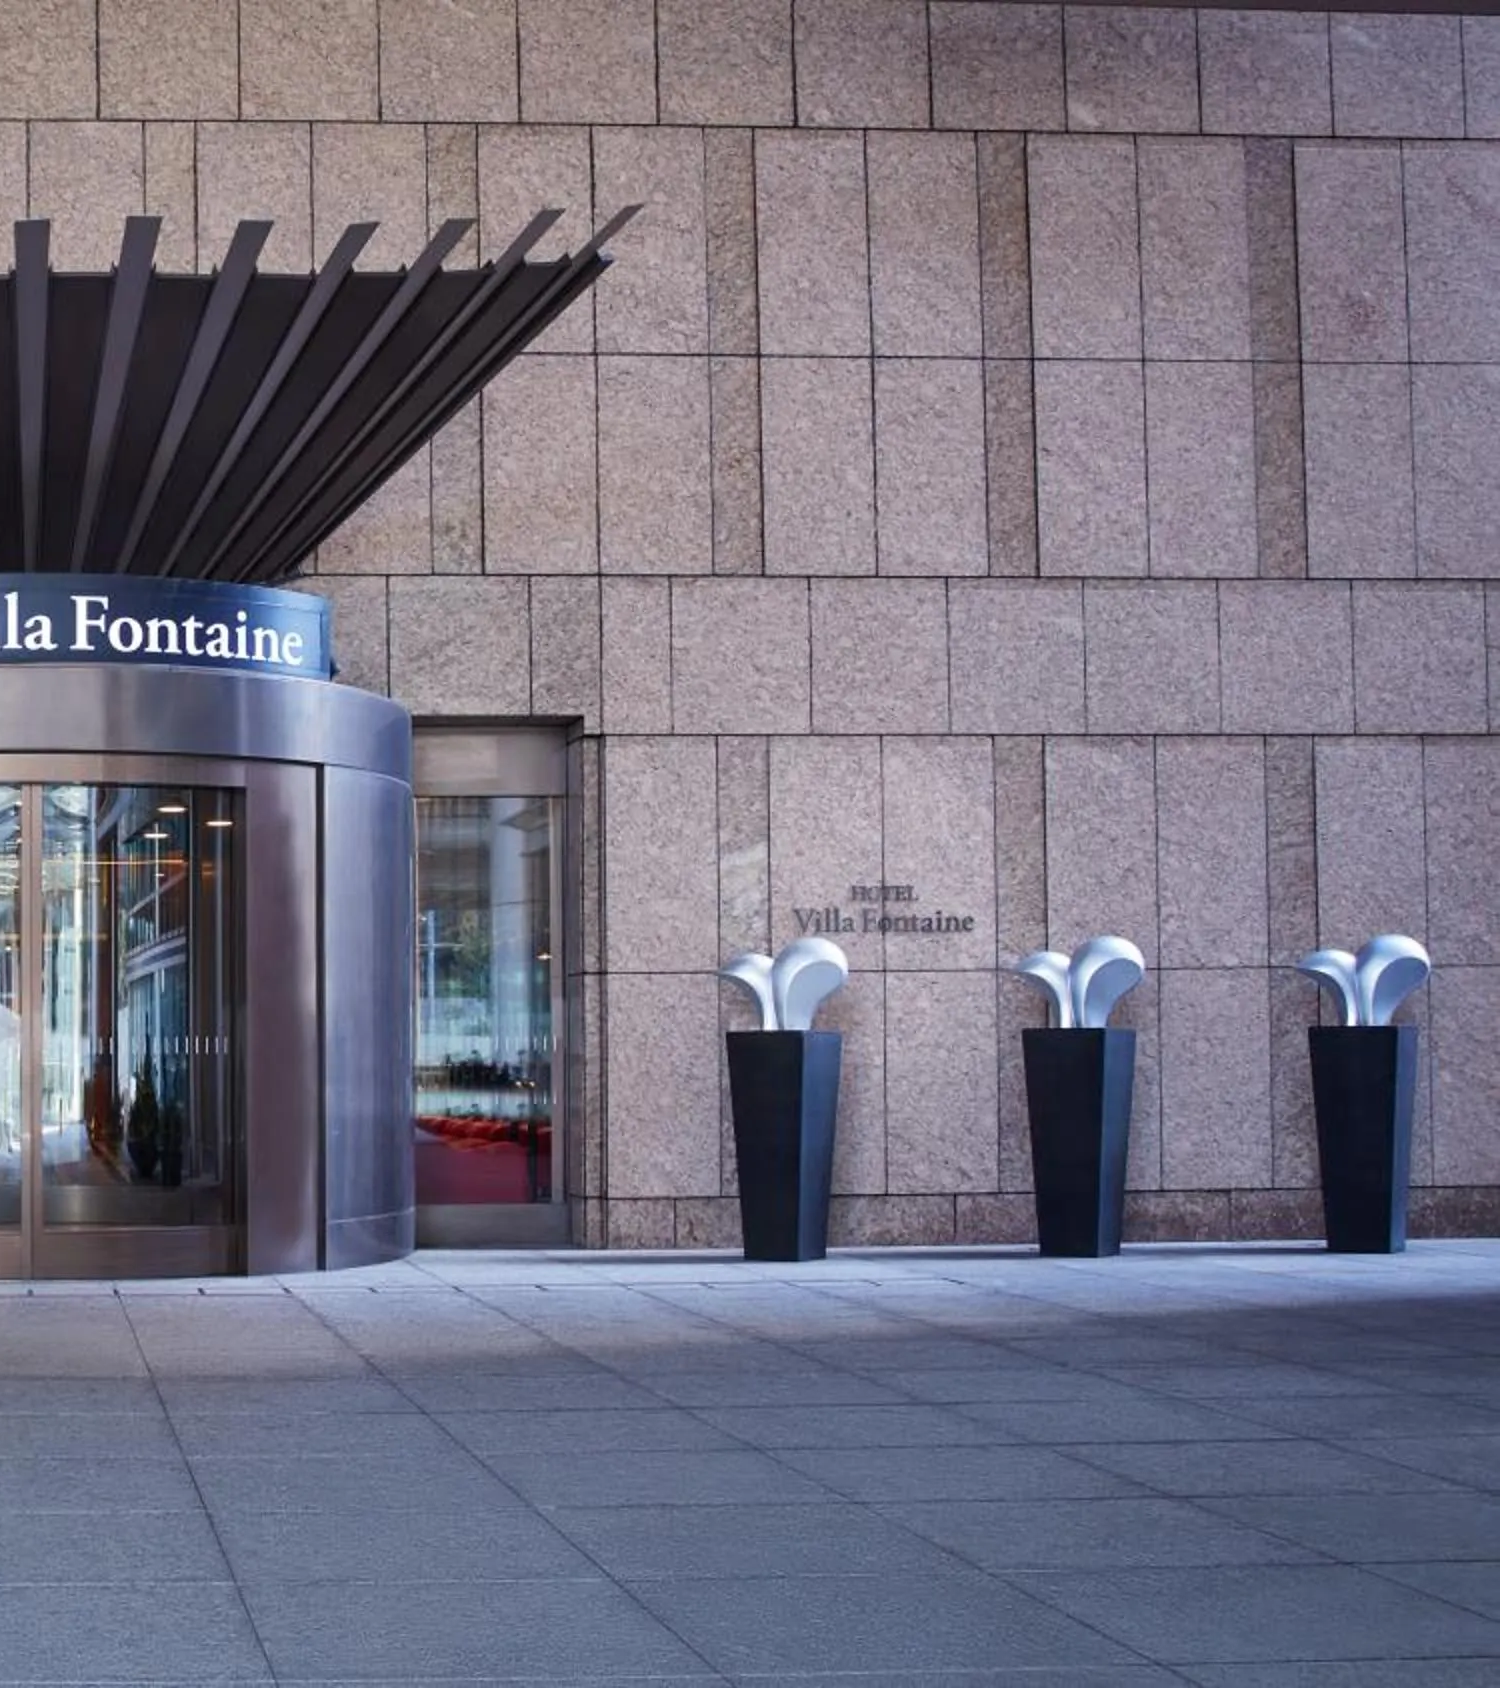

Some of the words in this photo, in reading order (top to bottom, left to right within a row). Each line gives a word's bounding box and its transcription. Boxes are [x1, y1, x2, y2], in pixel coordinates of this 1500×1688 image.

[70, 594, 305, 666] Fontaine
[850, 884, 919, 902] HOTEL
[793, 907, 856, 934] Villa
[861, 907, 976, 934] Fontaine
